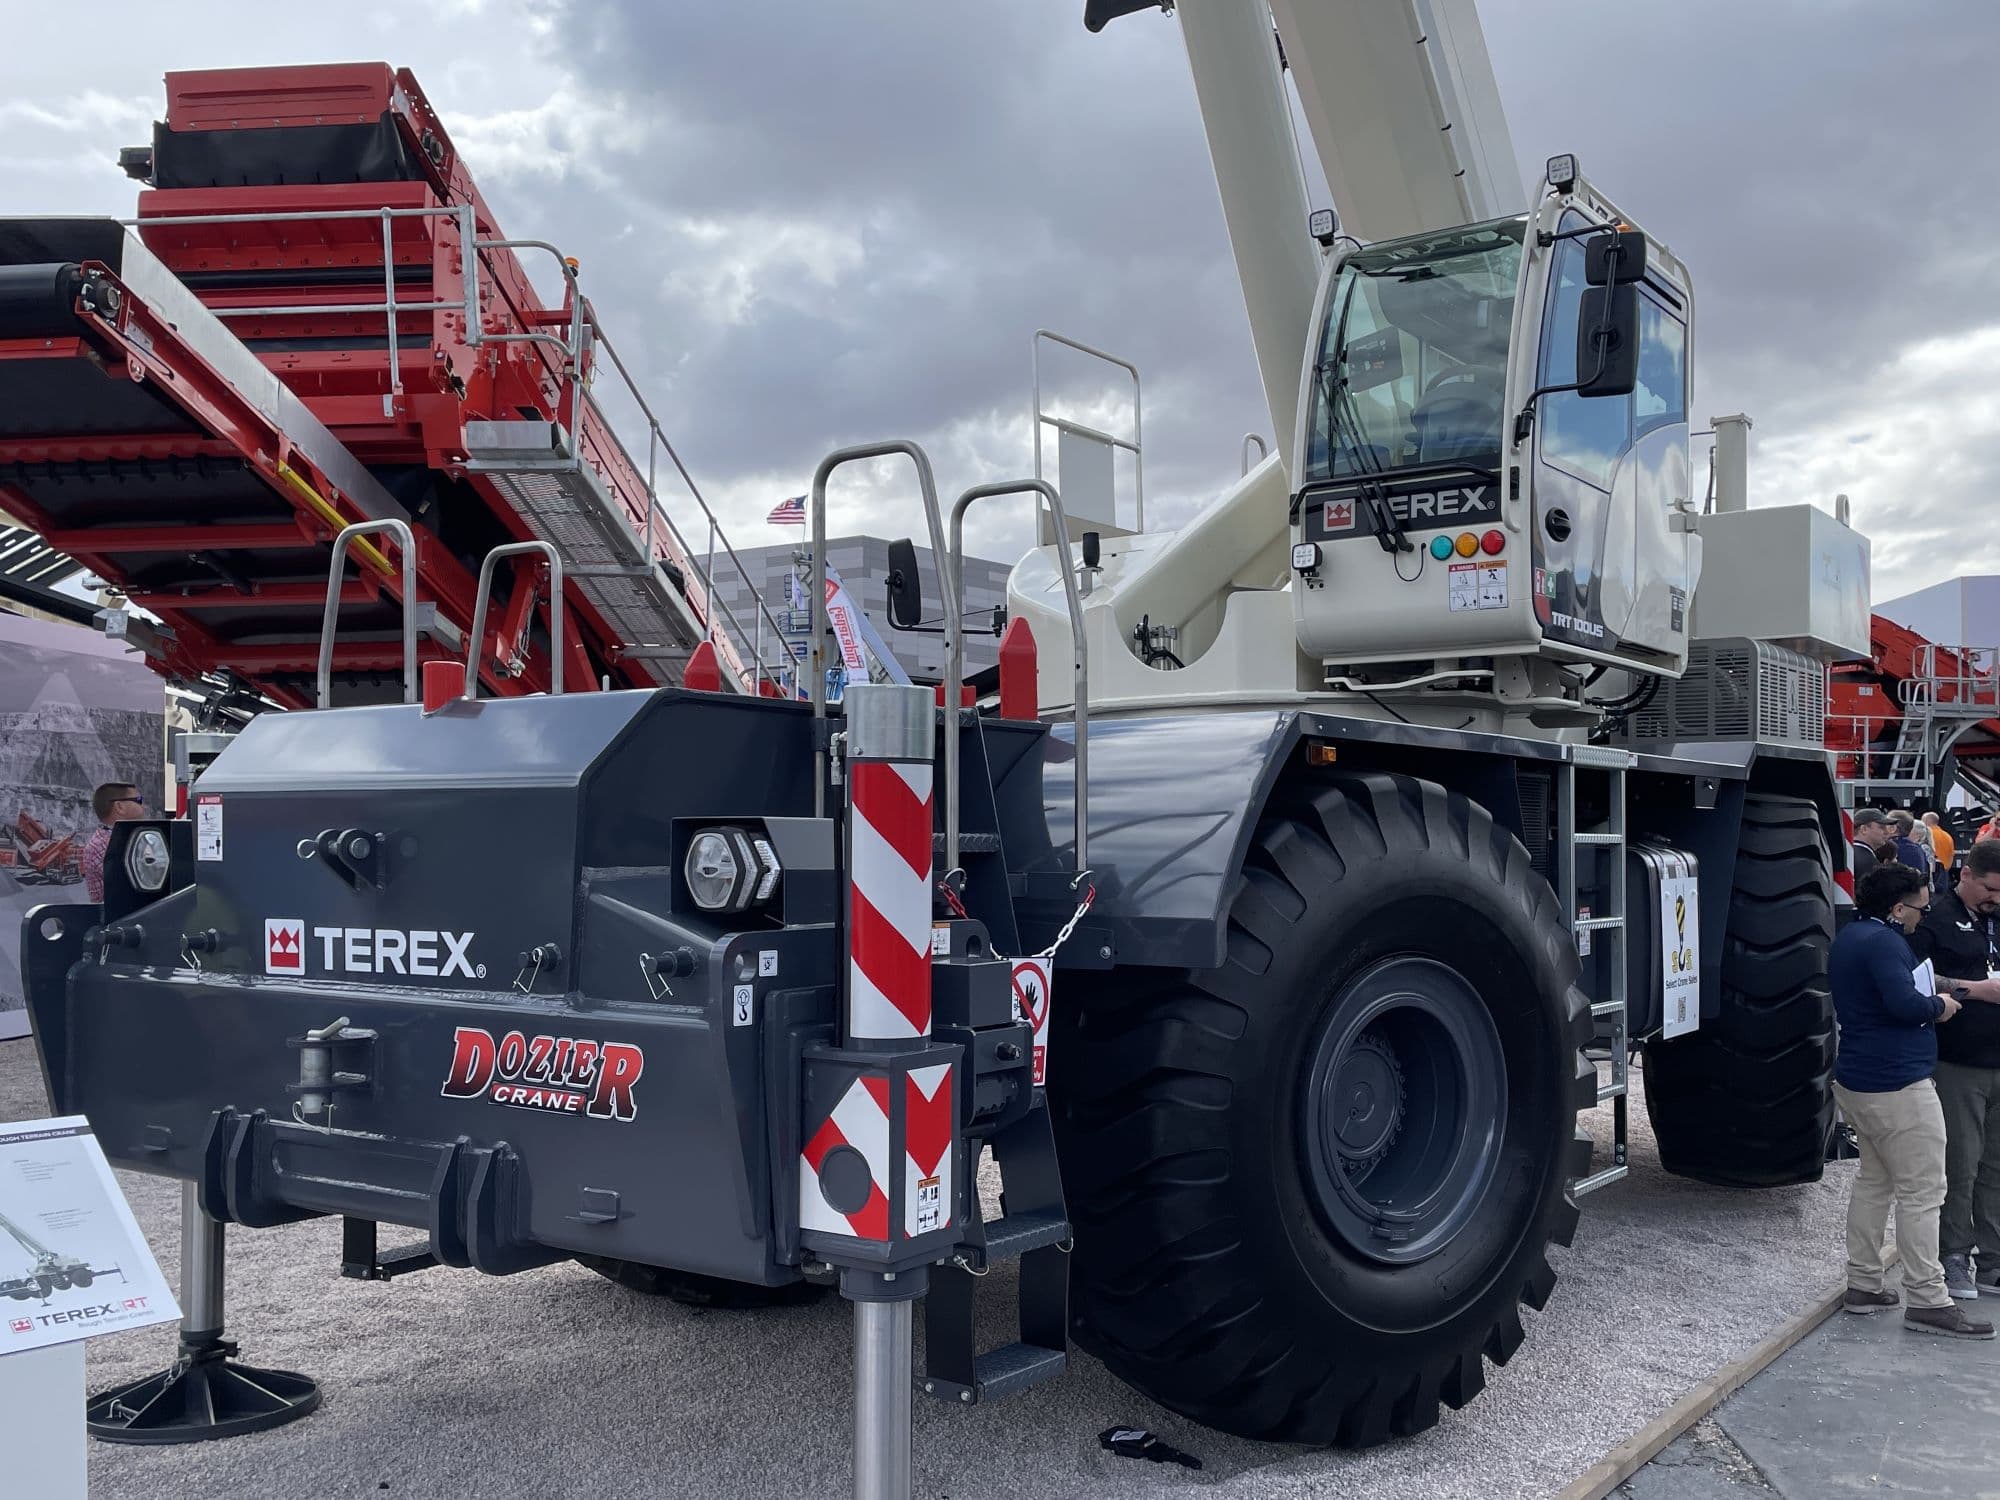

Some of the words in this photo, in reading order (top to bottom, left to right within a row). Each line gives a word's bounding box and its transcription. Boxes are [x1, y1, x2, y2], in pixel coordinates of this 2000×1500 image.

[1551, 611, 1572, 629] TRT
[1573, 617, 1604, 638] 100US
[314, 927, 477, 978] TEREX
[441, 1026, 644, 1122] DOZIER
[493, 1085, 582, 1112] CRANE
[0, 1135, 20, 1143] OUGH
[37, 1303, 115, 1327] TEREX
[121, 1297, 148, 1312] RT
